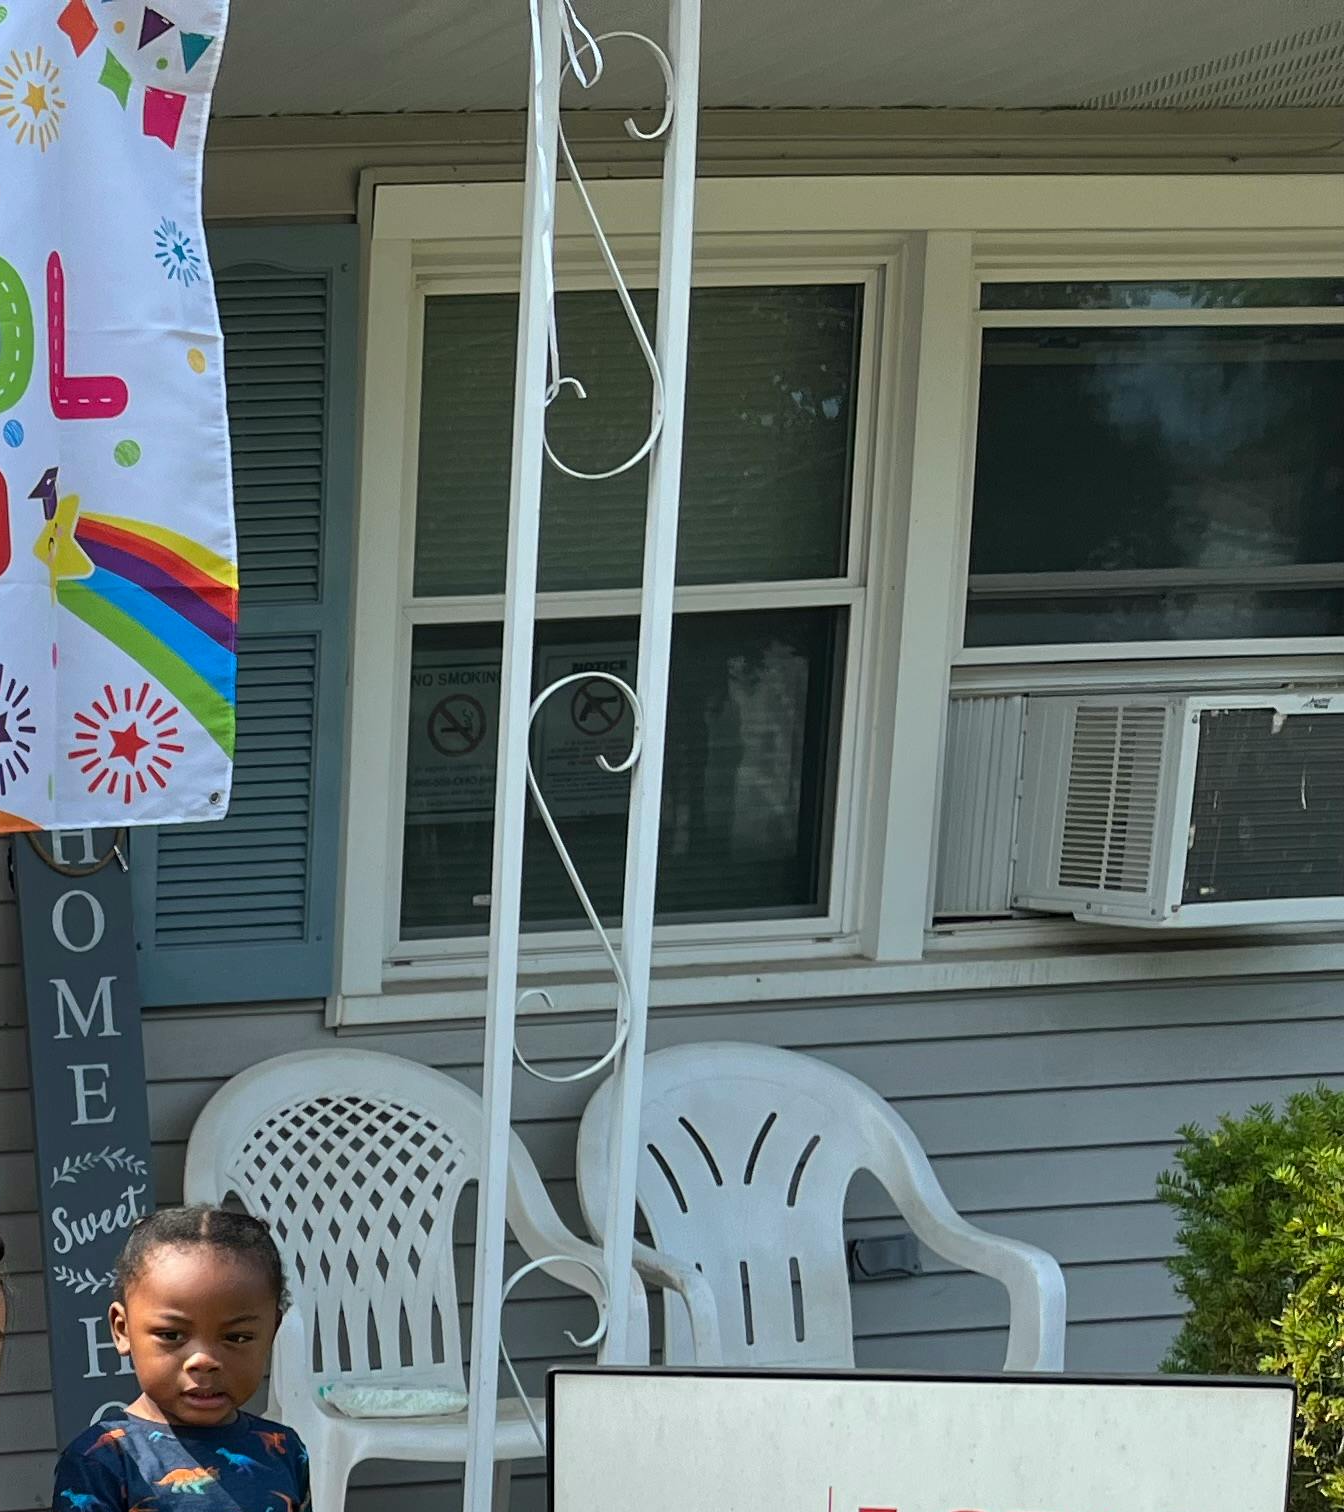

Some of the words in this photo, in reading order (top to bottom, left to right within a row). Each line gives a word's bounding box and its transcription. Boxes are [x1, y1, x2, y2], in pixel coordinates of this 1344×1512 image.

[413, 673, 433, 687] NO
[438, 670, 500, 686] SMOKIN
[52, 1184, 146, 1254] Sweet
